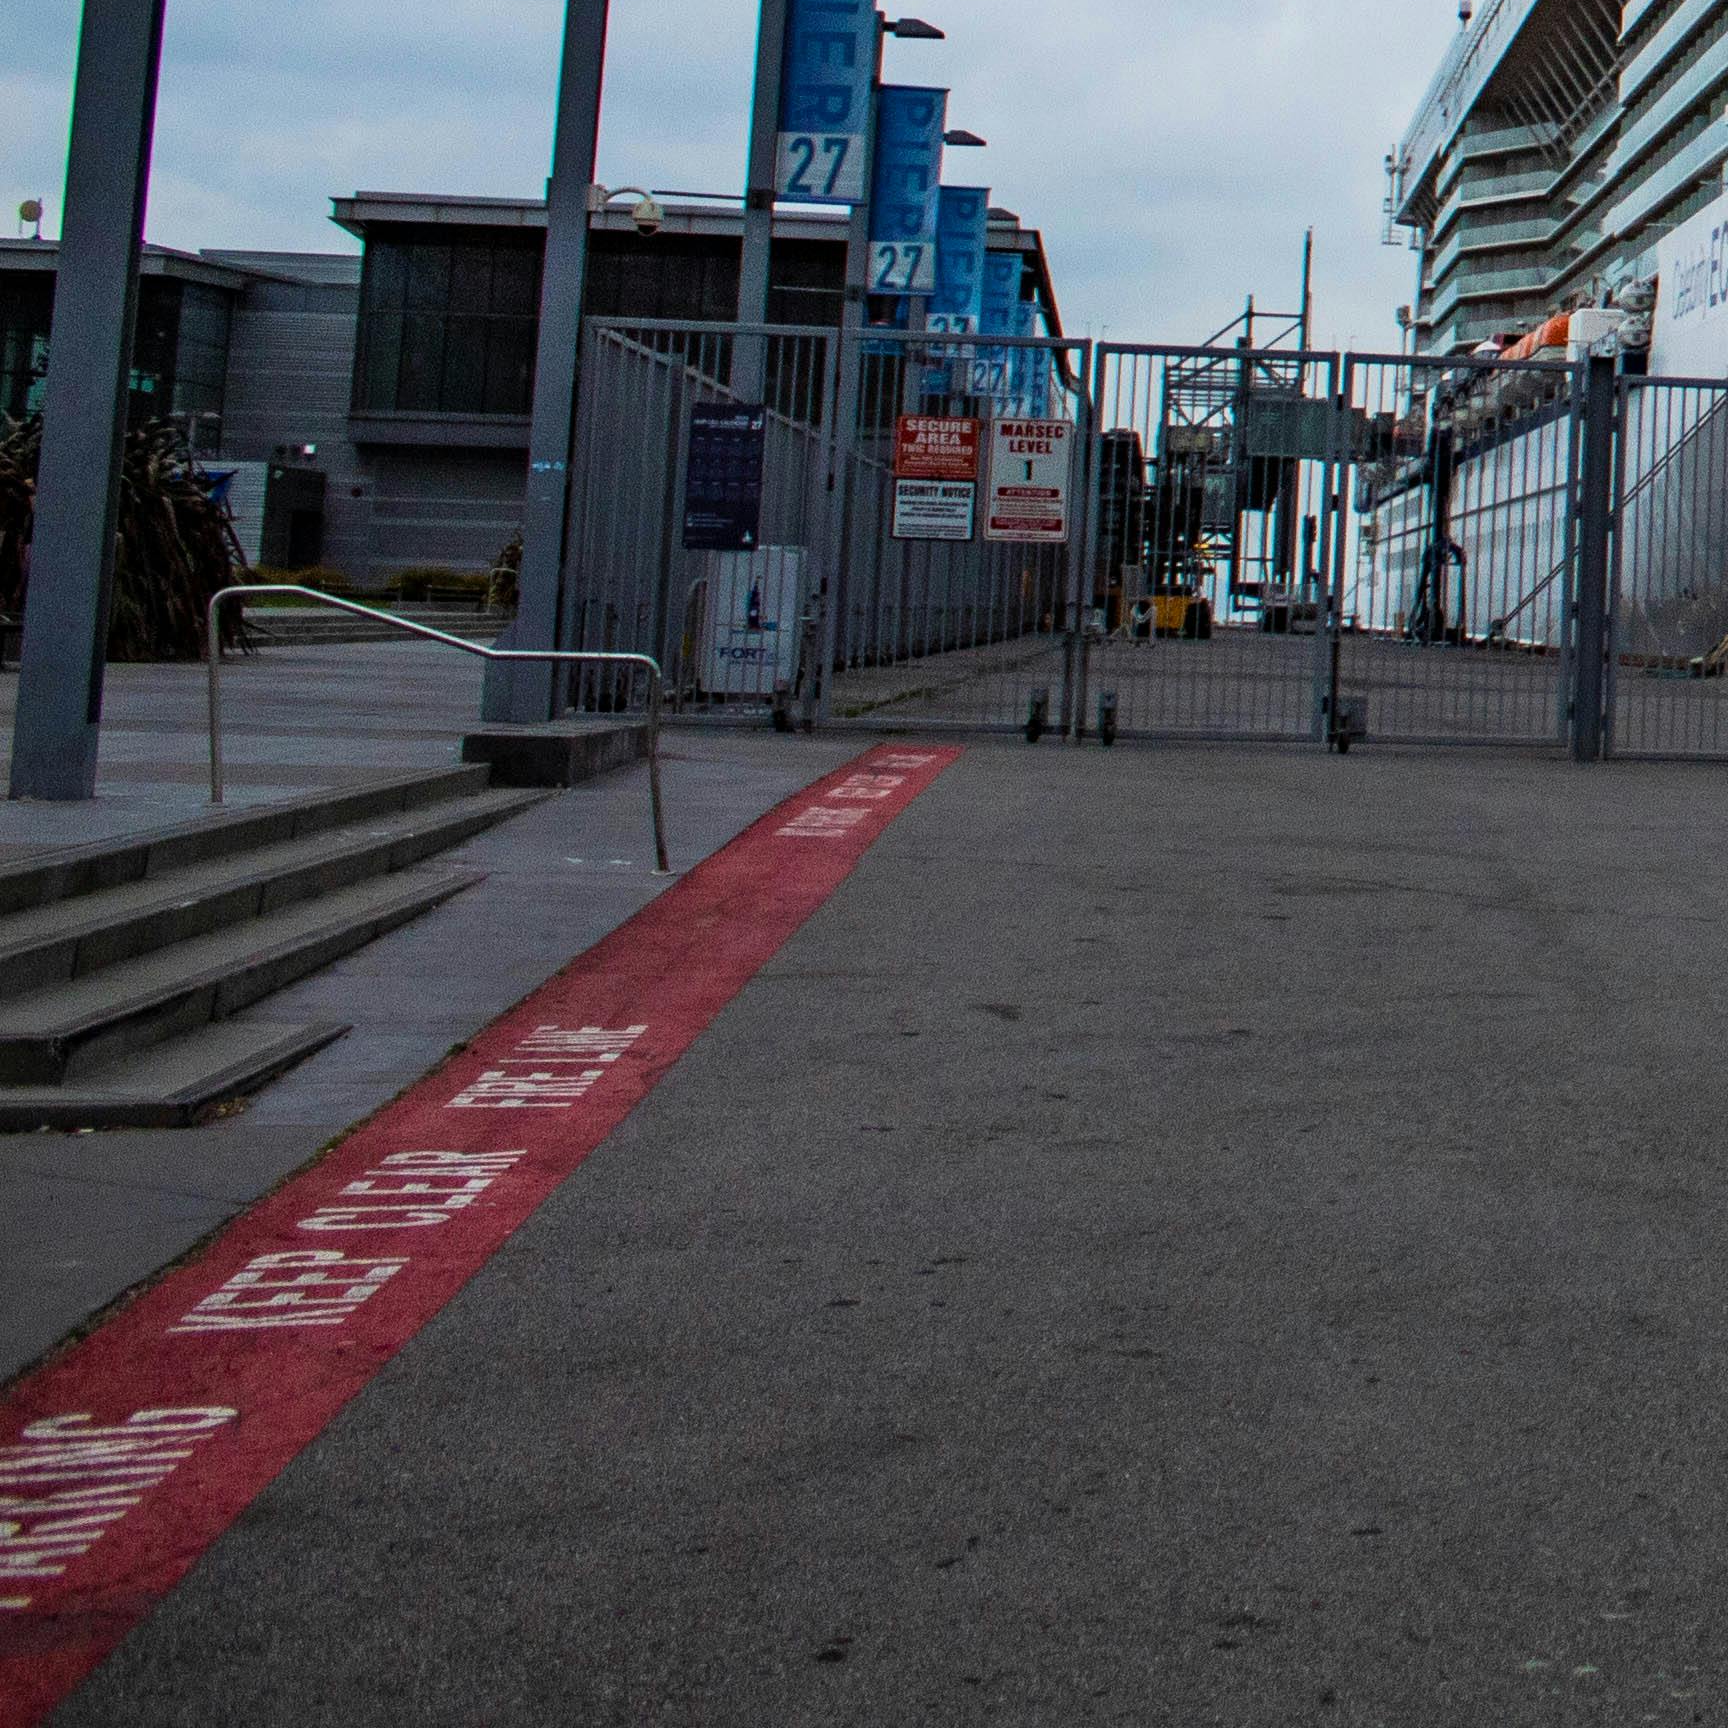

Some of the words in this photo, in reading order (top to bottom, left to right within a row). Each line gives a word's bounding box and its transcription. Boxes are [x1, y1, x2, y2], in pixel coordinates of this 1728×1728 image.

[786, 137, 849, 196] 27
[879, 97, 934, 237] PIER
[877, 245, 922, 290] 27
[972, 361, 1004, 392] 27
[906, 419, 972, 434] SECURE
[915, 433, 961, 444] AREA
[1001, 423, 1064, 439] MARSEC
[1009, 440, 1053, 454] LEVEL
[1024, 459, 1033, 480] 1
[898, 484, 939, 498] SECURITY
[941, 485, 972, 499] NOTICE
[499, 1025, 649, 1063] LANE
[443, 1070, 604, 1109] FIRE
[166, 1249, 411, 1333] KEEP
[297, 1149, 528, 1231] CLEAR
[0, 1406, 240, 1608] RKING
